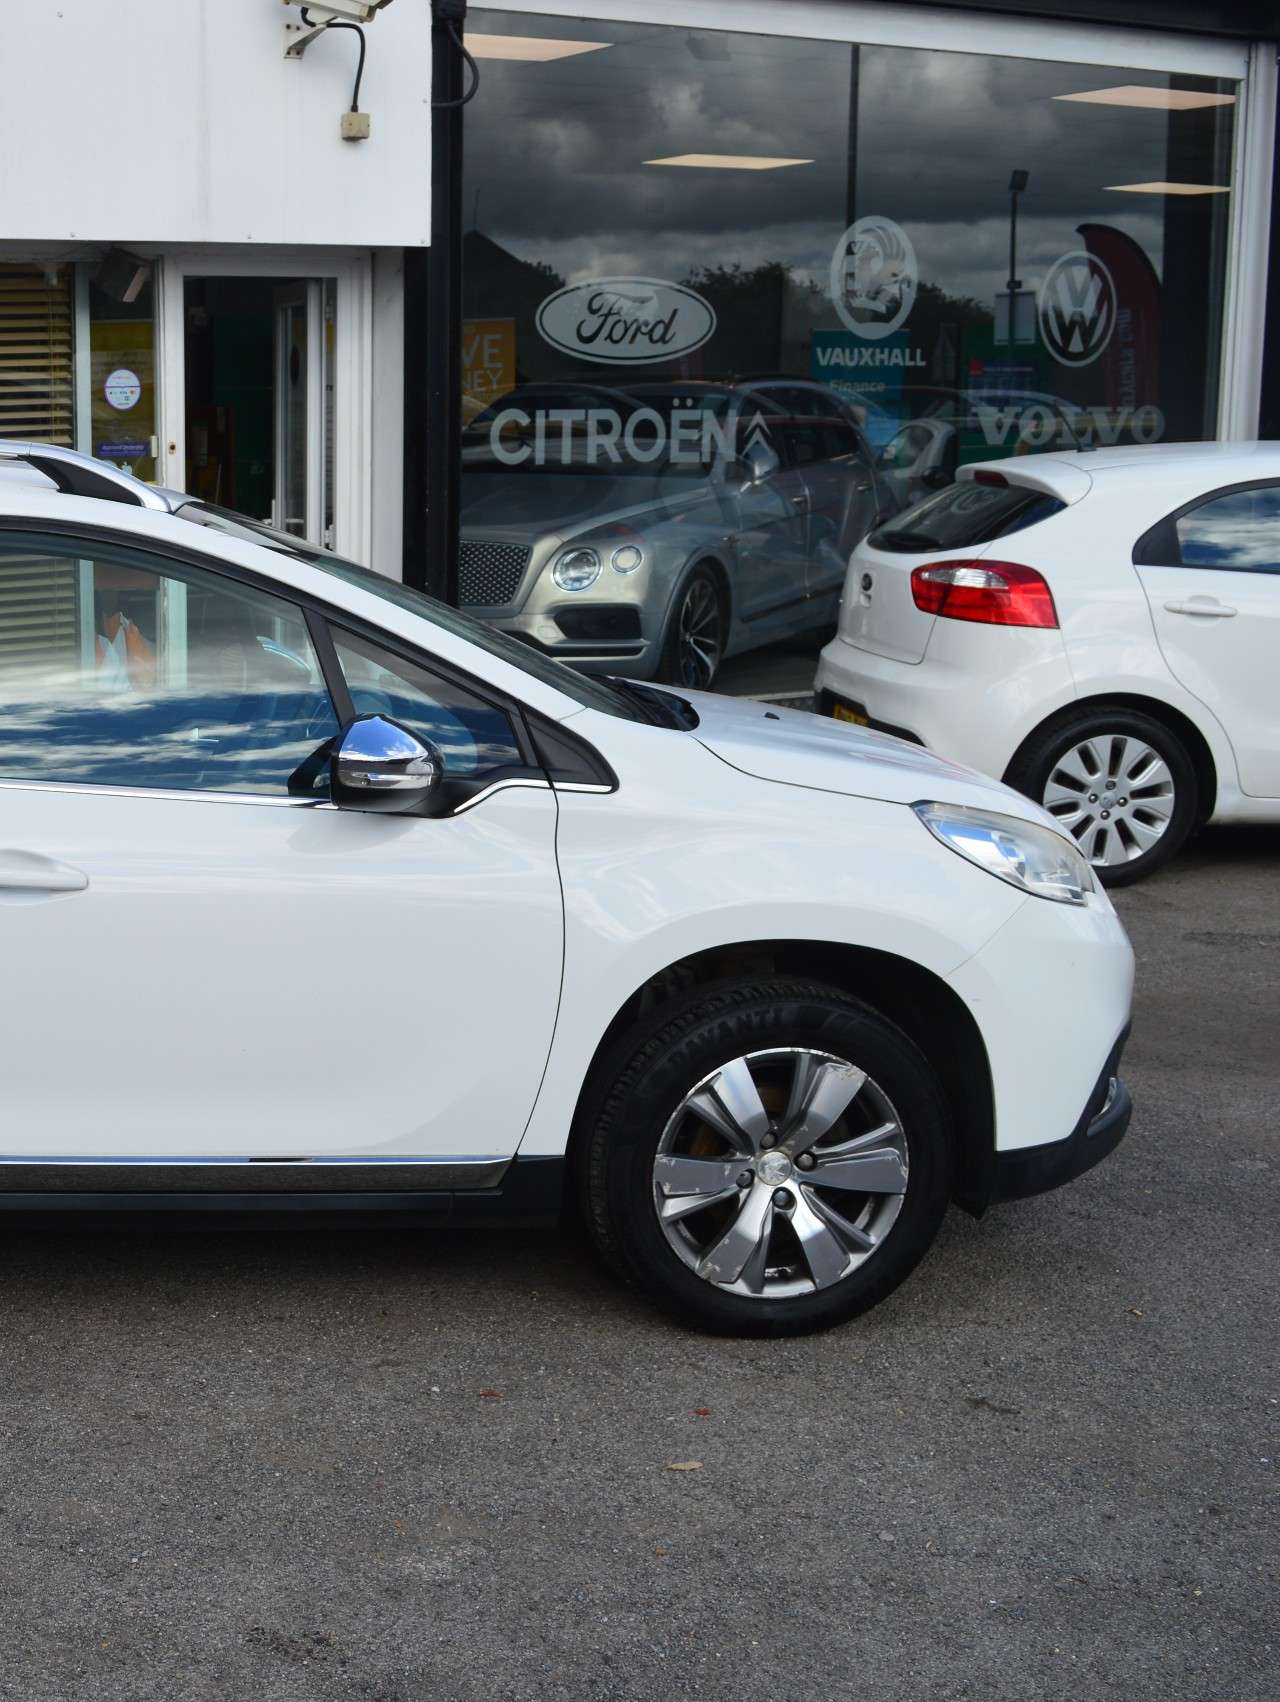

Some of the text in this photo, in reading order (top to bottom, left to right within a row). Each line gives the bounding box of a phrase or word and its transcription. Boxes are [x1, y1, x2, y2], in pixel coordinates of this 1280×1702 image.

[576, 292, 679, 345] Ford
[816, 347, 927, 367] VAUXHALL
[829, 380, 886, 393] Finance
[490, 398, 737, 465] CITROËN
[972, 404, 1166, 446] VOLVO
